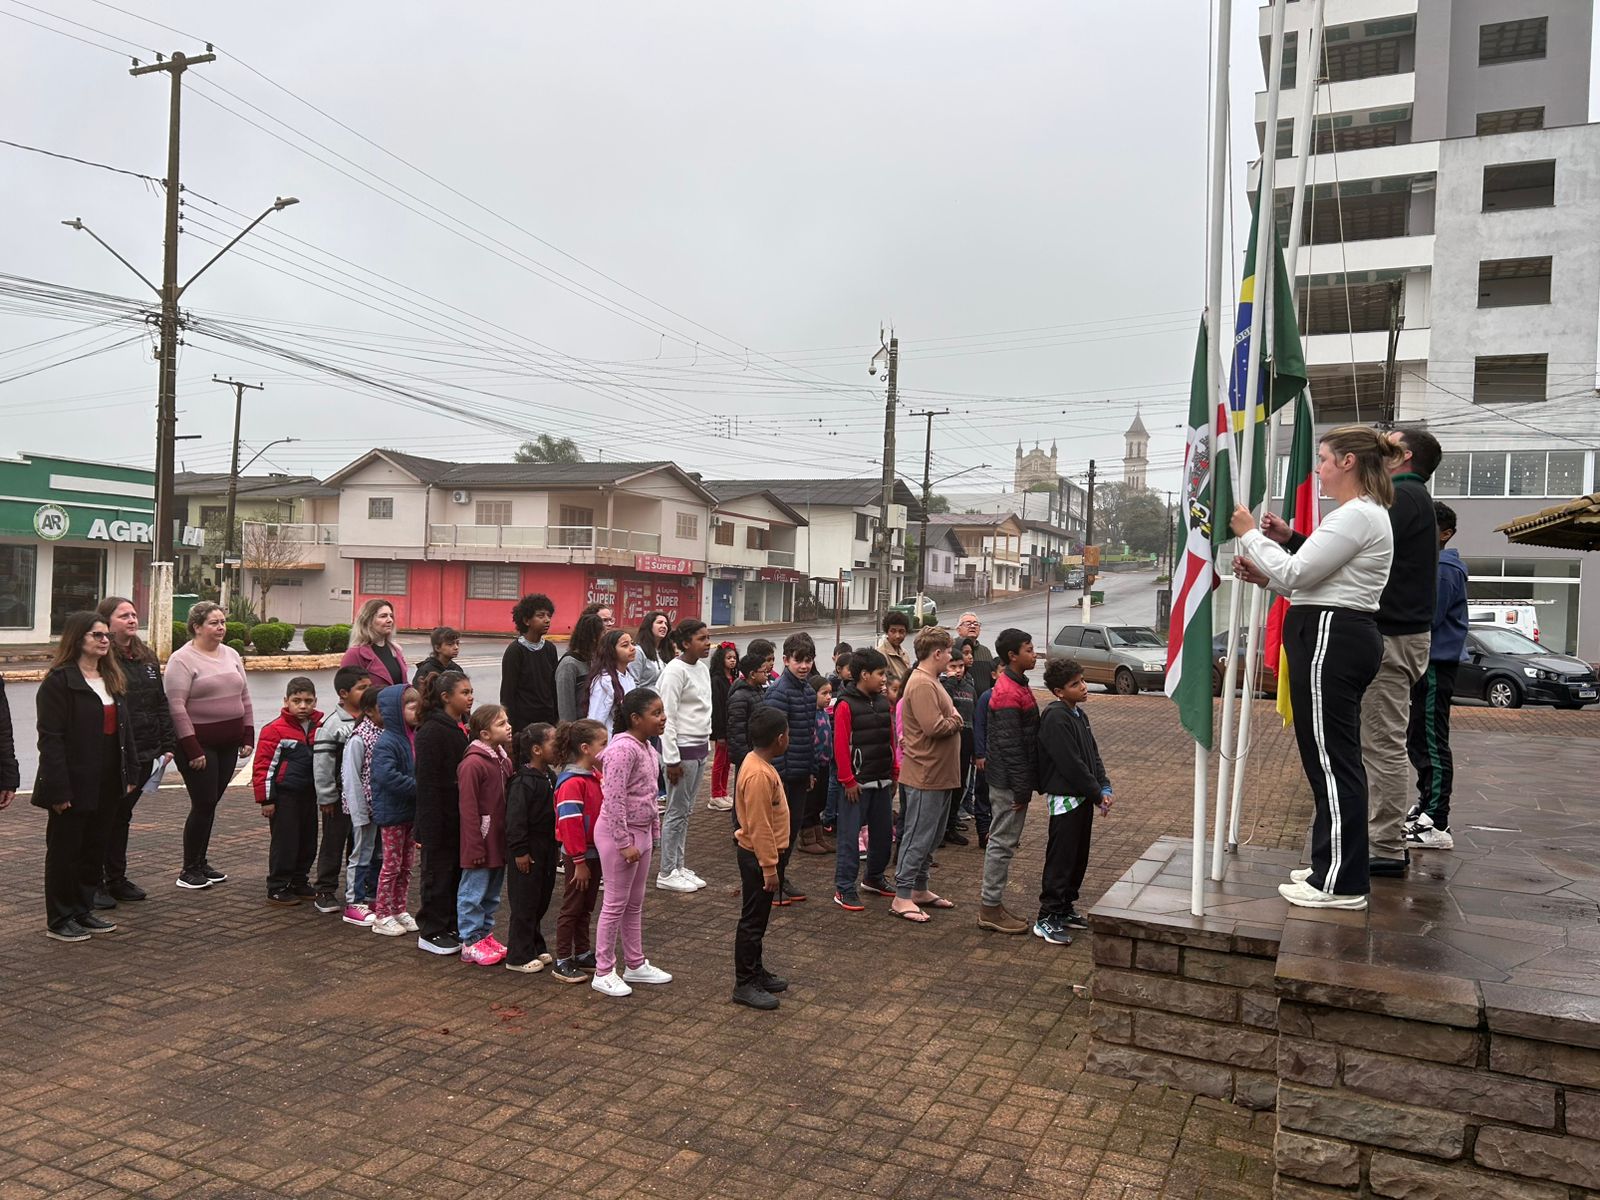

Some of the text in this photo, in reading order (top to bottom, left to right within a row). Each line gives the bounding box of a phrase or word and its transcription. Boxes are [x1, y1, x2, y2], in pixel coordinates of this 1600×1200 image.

[41, 514, 62, 530] AR
[651, 562, 677, 571] SUPER
[587, 591, 615, 605] SUPER
[656, 594, 679, 606] SUPER
